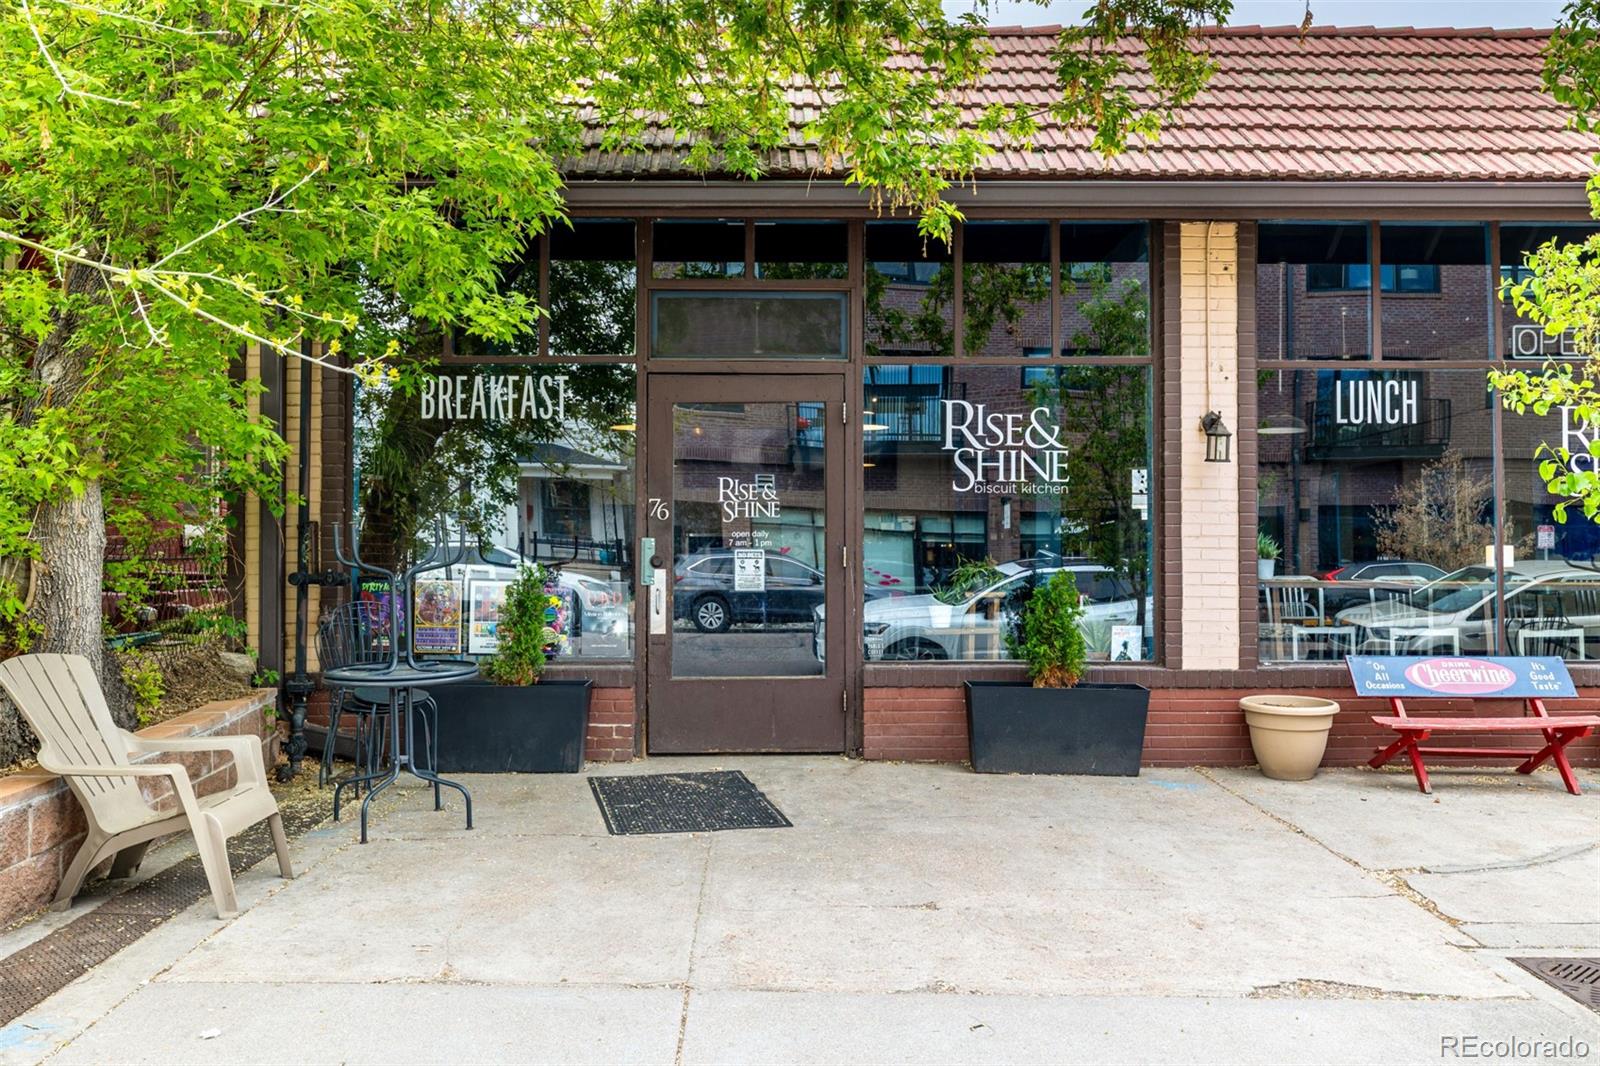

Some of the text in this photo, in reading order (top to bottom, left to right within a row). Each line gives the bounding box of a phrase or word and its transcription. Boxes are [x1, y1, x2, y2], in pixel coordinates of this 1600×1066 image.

[1518, 329, 1598, 354] OPE
[421, 375, 569, 420] BREAKFAST
[1336, 380, 1417, 424] LUNCH
[952, 448, 1070, 492] SHINE
[974, 482, 1069, 494] biscuit kitchen
[648, 498, 670, 521] 76
[722, 501, 781, 523] SHINE
[728, 539, 733, 547] 7
[731, 530, 769, 539] open daily
[1530, 662, 1546, 671] It's
[1375, 673, 1390, 681] All
[1412, 663, 1509, 688] Cheerwine
[1529, 671, 1555, 681] Good
[1365, 680, 1406, 690] Occasions
